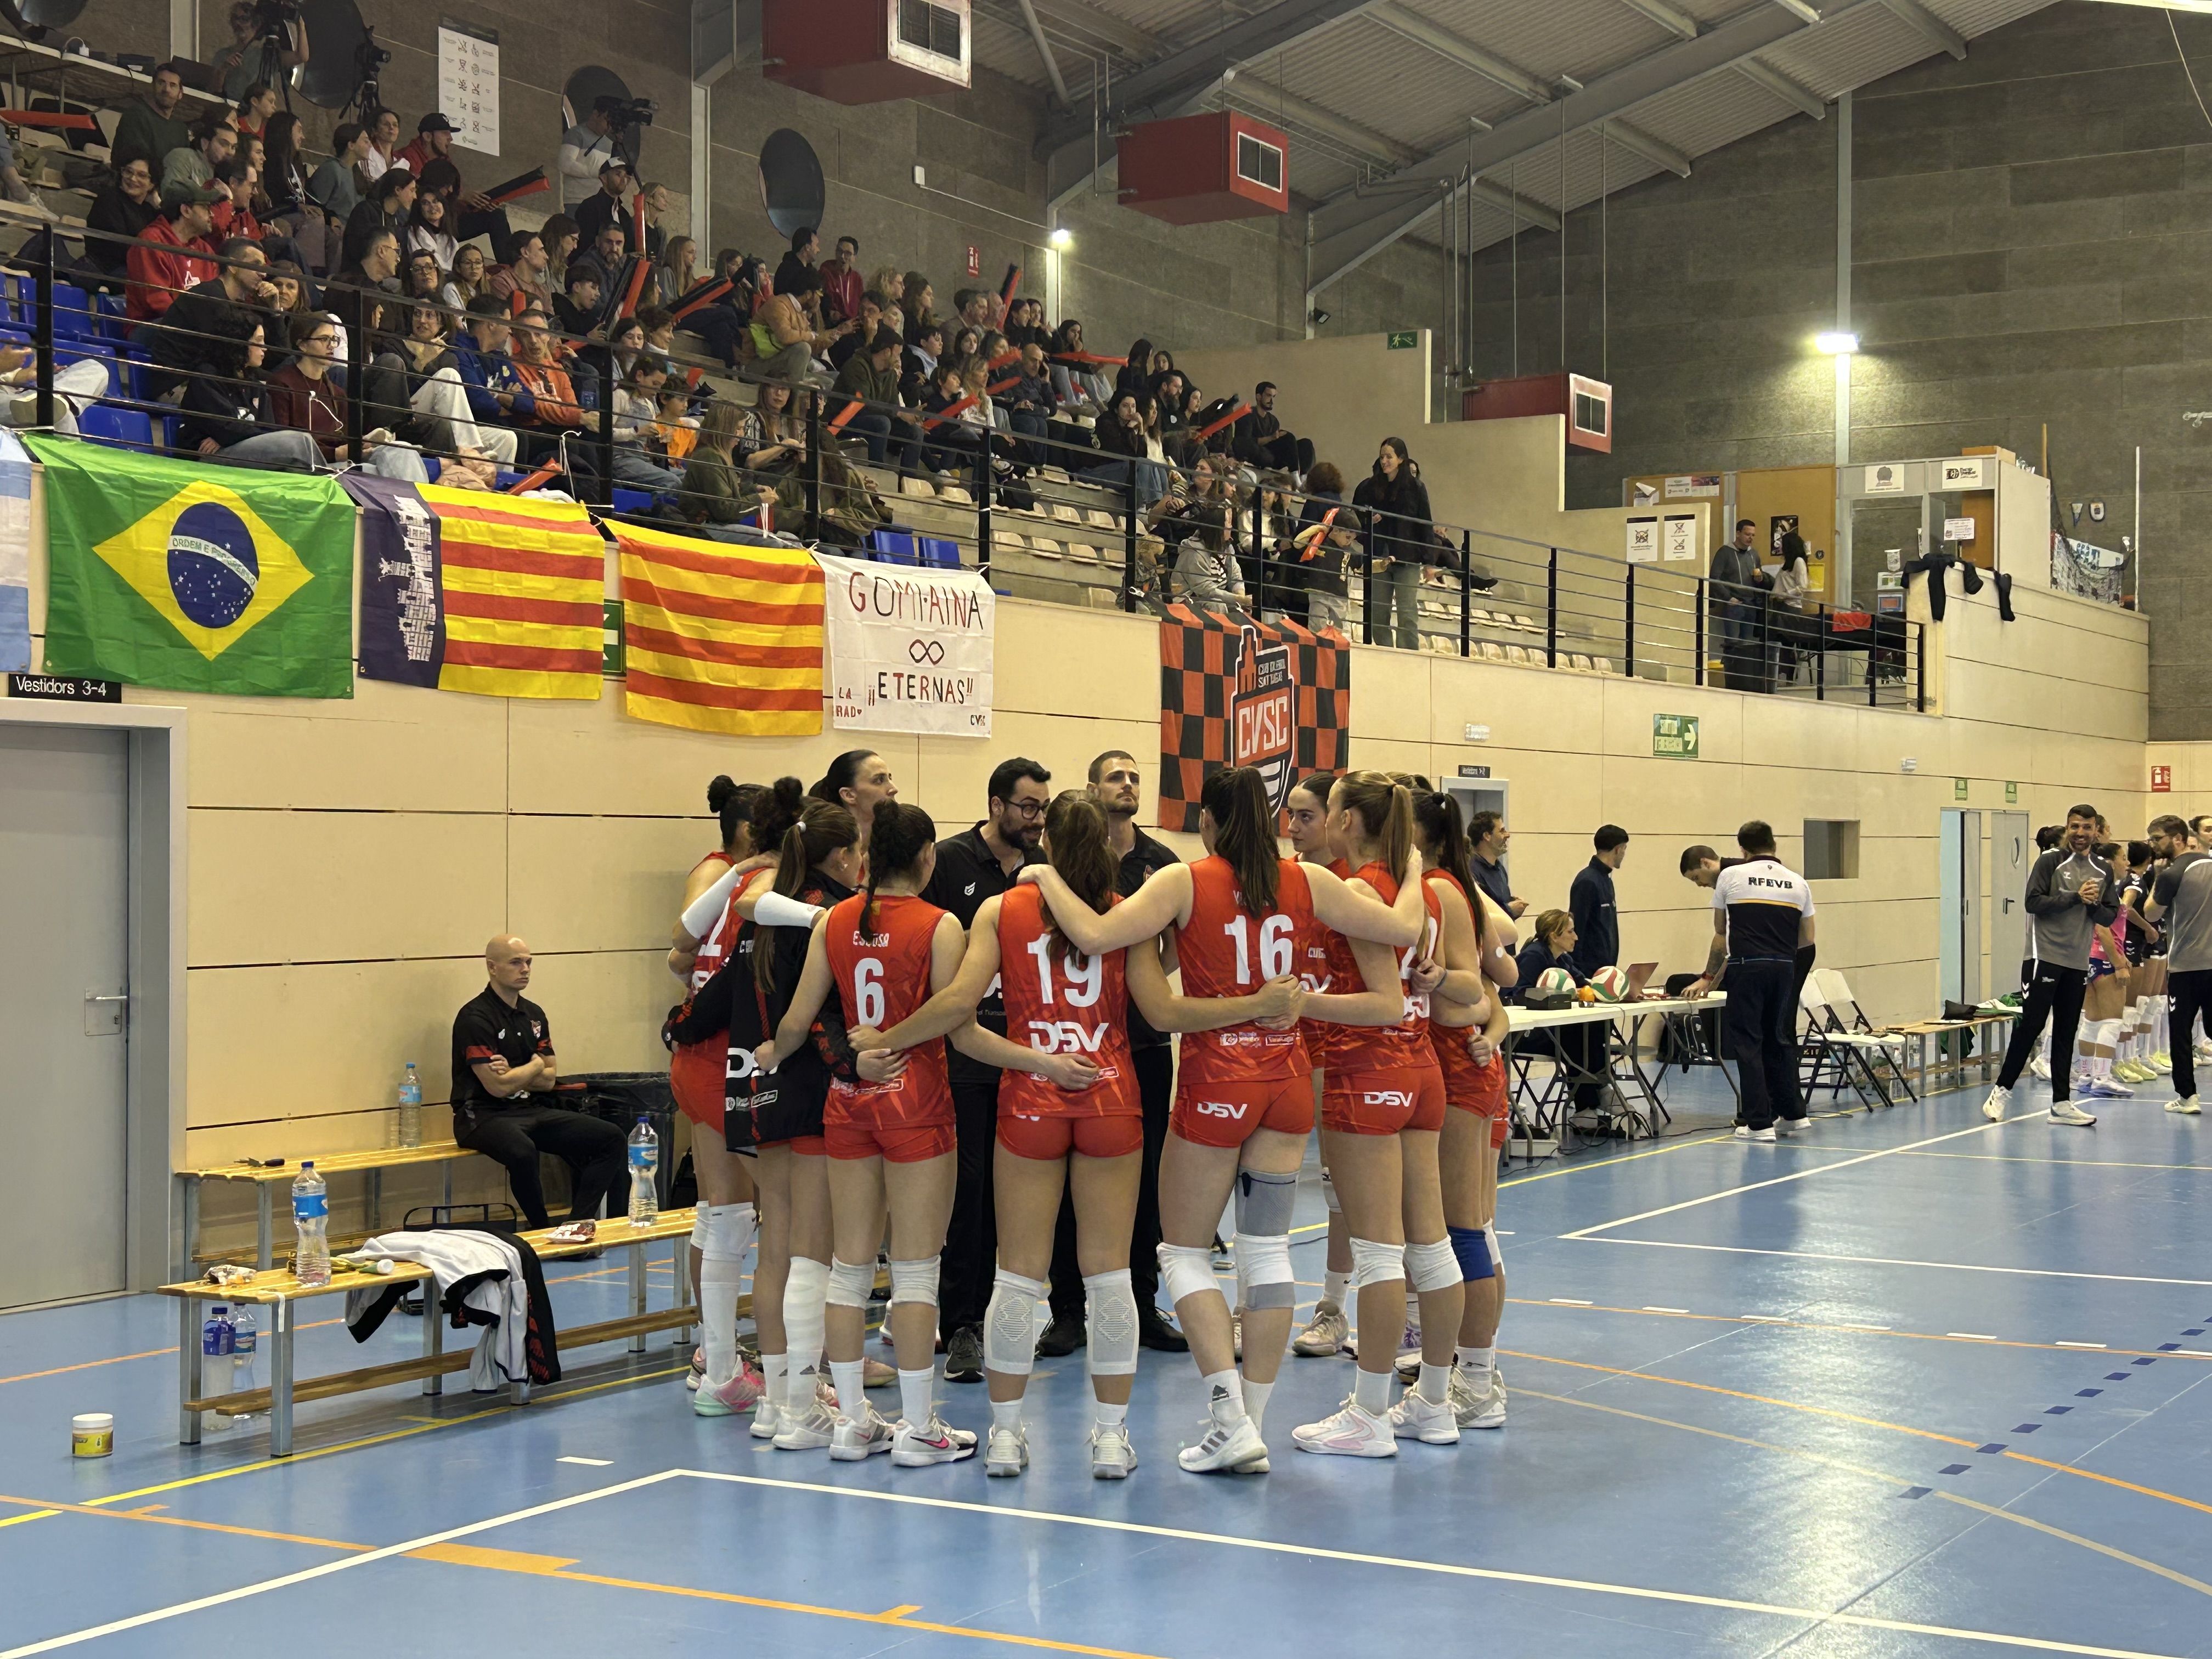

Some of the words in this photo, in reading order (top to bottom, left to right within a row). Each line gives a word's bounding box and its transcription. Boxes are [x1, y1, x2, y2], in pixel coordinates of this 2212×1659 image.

[16, 676, 75, 695] Vestidors
[82, 680, 106, 696] 3-4
[839, 687, 852, 699] LA
[1238, 696, 1288, 759] CVSC
[1748, 877, 1793, 889] RFEVB
[1224, 914, 1294, 985] 16
[1027, 934, 1102, 1007] 19
[854, 957, 885, 1028] 6
[1028, 1020, 1109, 1053] DSV
[1197, 1101, 1248, 1119] DSV
[1363, 1091, 1413, 1107] DSV
